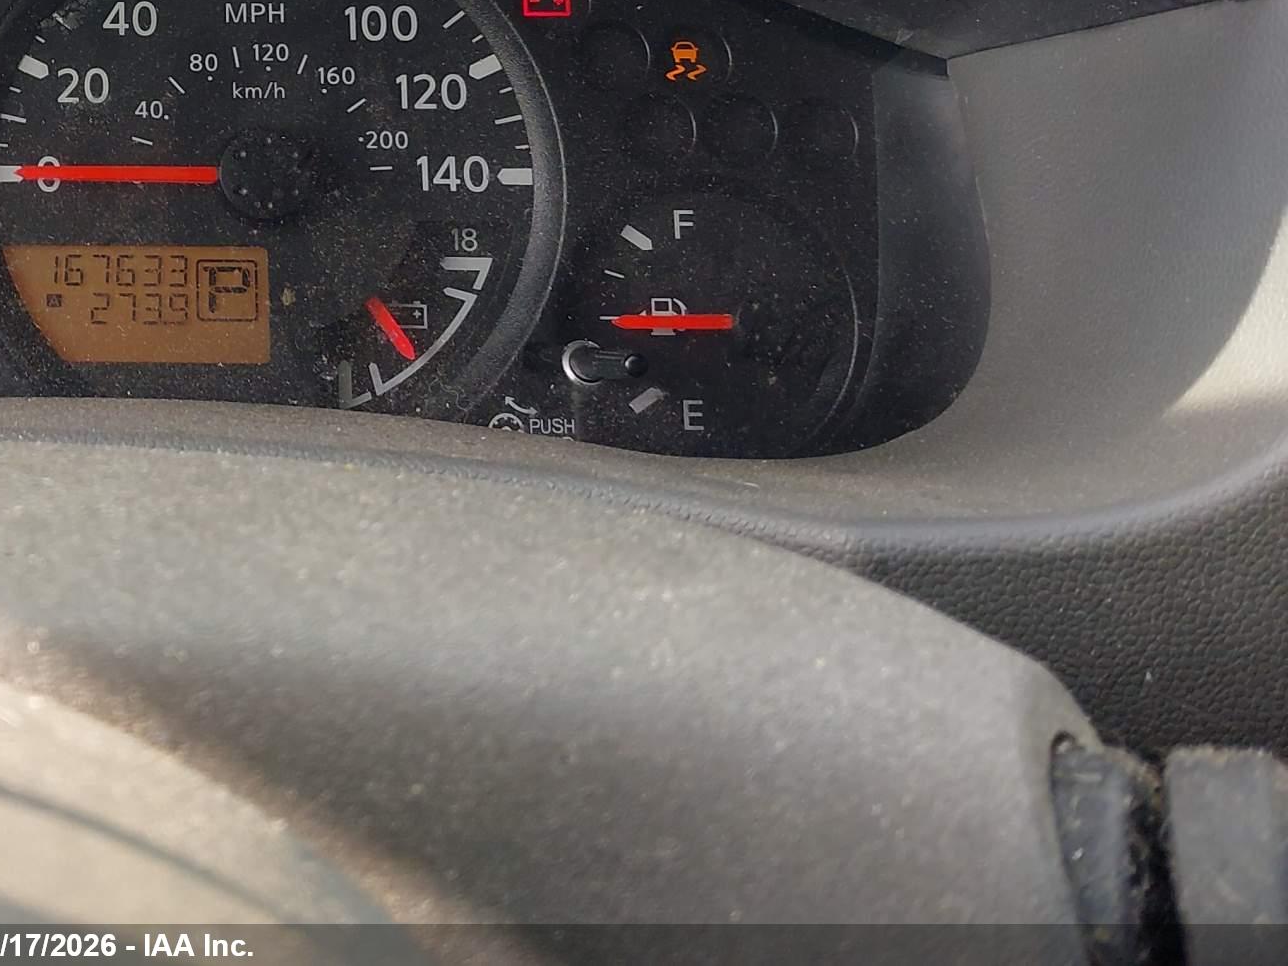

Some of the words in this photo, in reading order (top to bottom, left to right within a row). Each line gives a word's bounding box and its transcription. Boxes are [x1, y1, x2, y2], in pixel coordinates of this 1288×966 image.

[102, 0, 158, 36] 40
[225, 3, 285, 24] MPH
[345, 5, 418, 42] 100
[189, 54, 218, 72] 80
[253, 44, 289, 61] 120
[57, 69, 109, 103] 20
[318, 67, 355, 85] 160
[232, 81, 285, 101] km/h
[397, 74, 467, 110] 120
[135, 100, 163, 119] 40
[366, 131, 408, 149] 200
[37, 156, 61, 193] 0
[417, 156, 489, 192] 140
[673, 210, 694, 239] F
[451, 229, 477, 250] 18
[54, 255, 188, 286] 167633
[203, 266, 250, 313] P
[529, 418, 575, 434] PUSH
[683, 400, 704, 431] E
